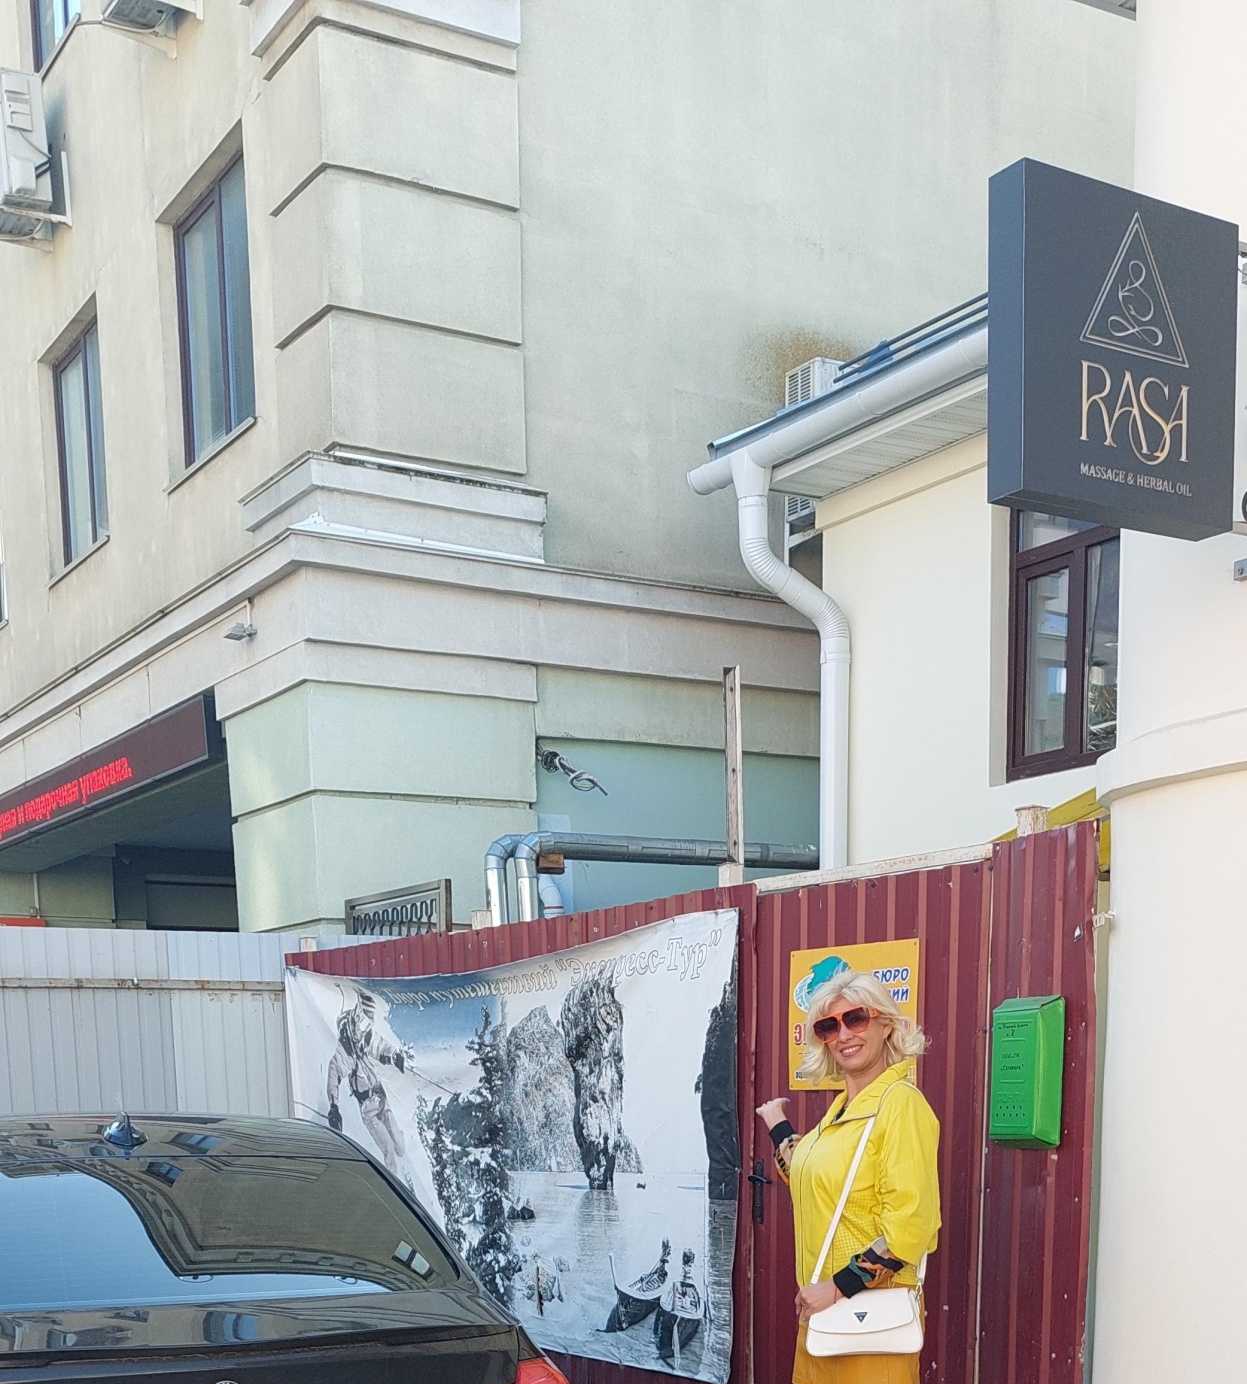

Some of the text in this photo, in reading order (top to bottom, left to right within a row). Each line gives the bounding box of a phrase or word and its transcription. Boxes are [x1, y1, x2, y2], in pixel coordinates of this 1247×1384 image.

[1080, 360, 1191, 466] RASA
[1080, 462, 1192, 497] MASSAGE & HERBAL OIL
[25, 779, 79, 820] подарочная
